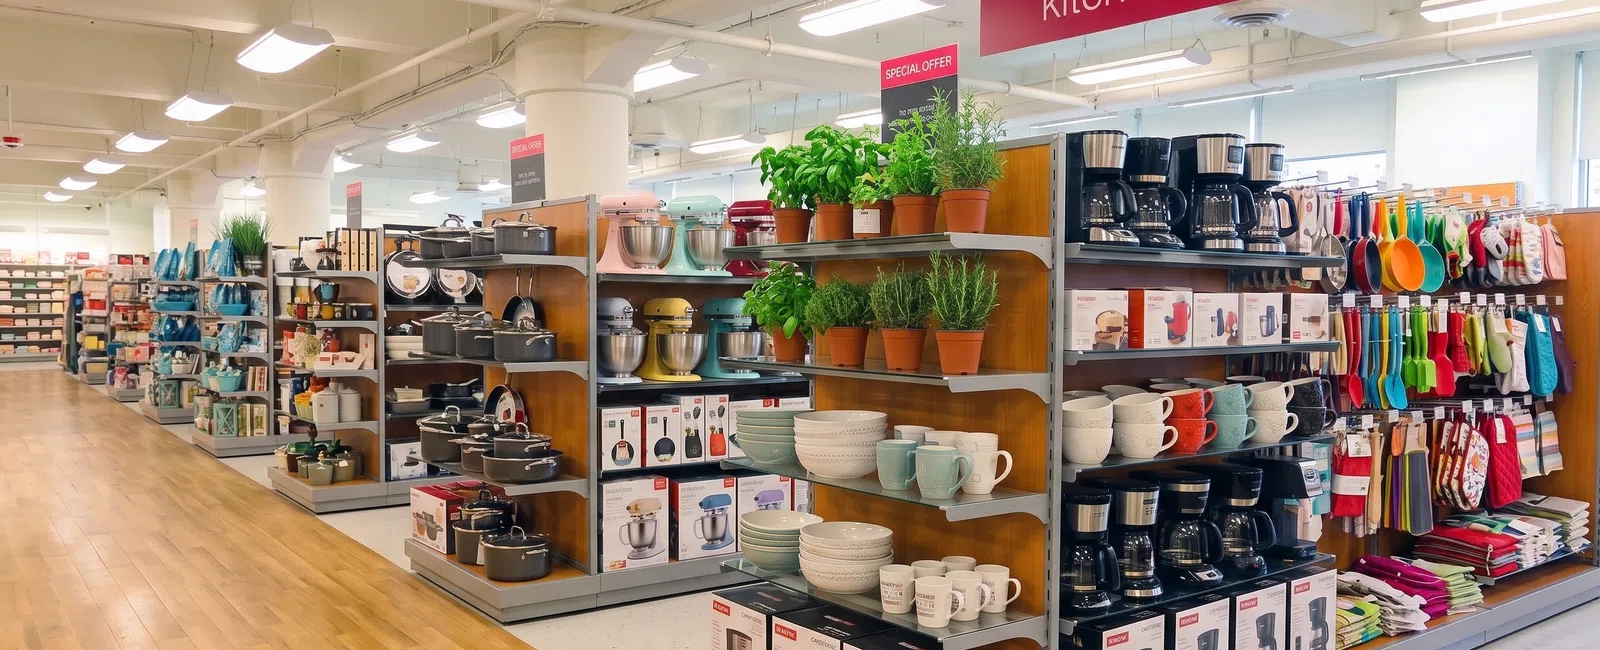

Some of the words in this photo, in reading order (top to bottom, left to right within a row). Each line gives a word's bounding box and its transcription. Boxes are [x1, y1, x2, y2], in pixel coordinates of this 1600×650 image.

[1043, 0, 1125, 21] kitc
[885, 63, 921, 80] SPECIAL
[921, 55, 952, 72] OFFER
